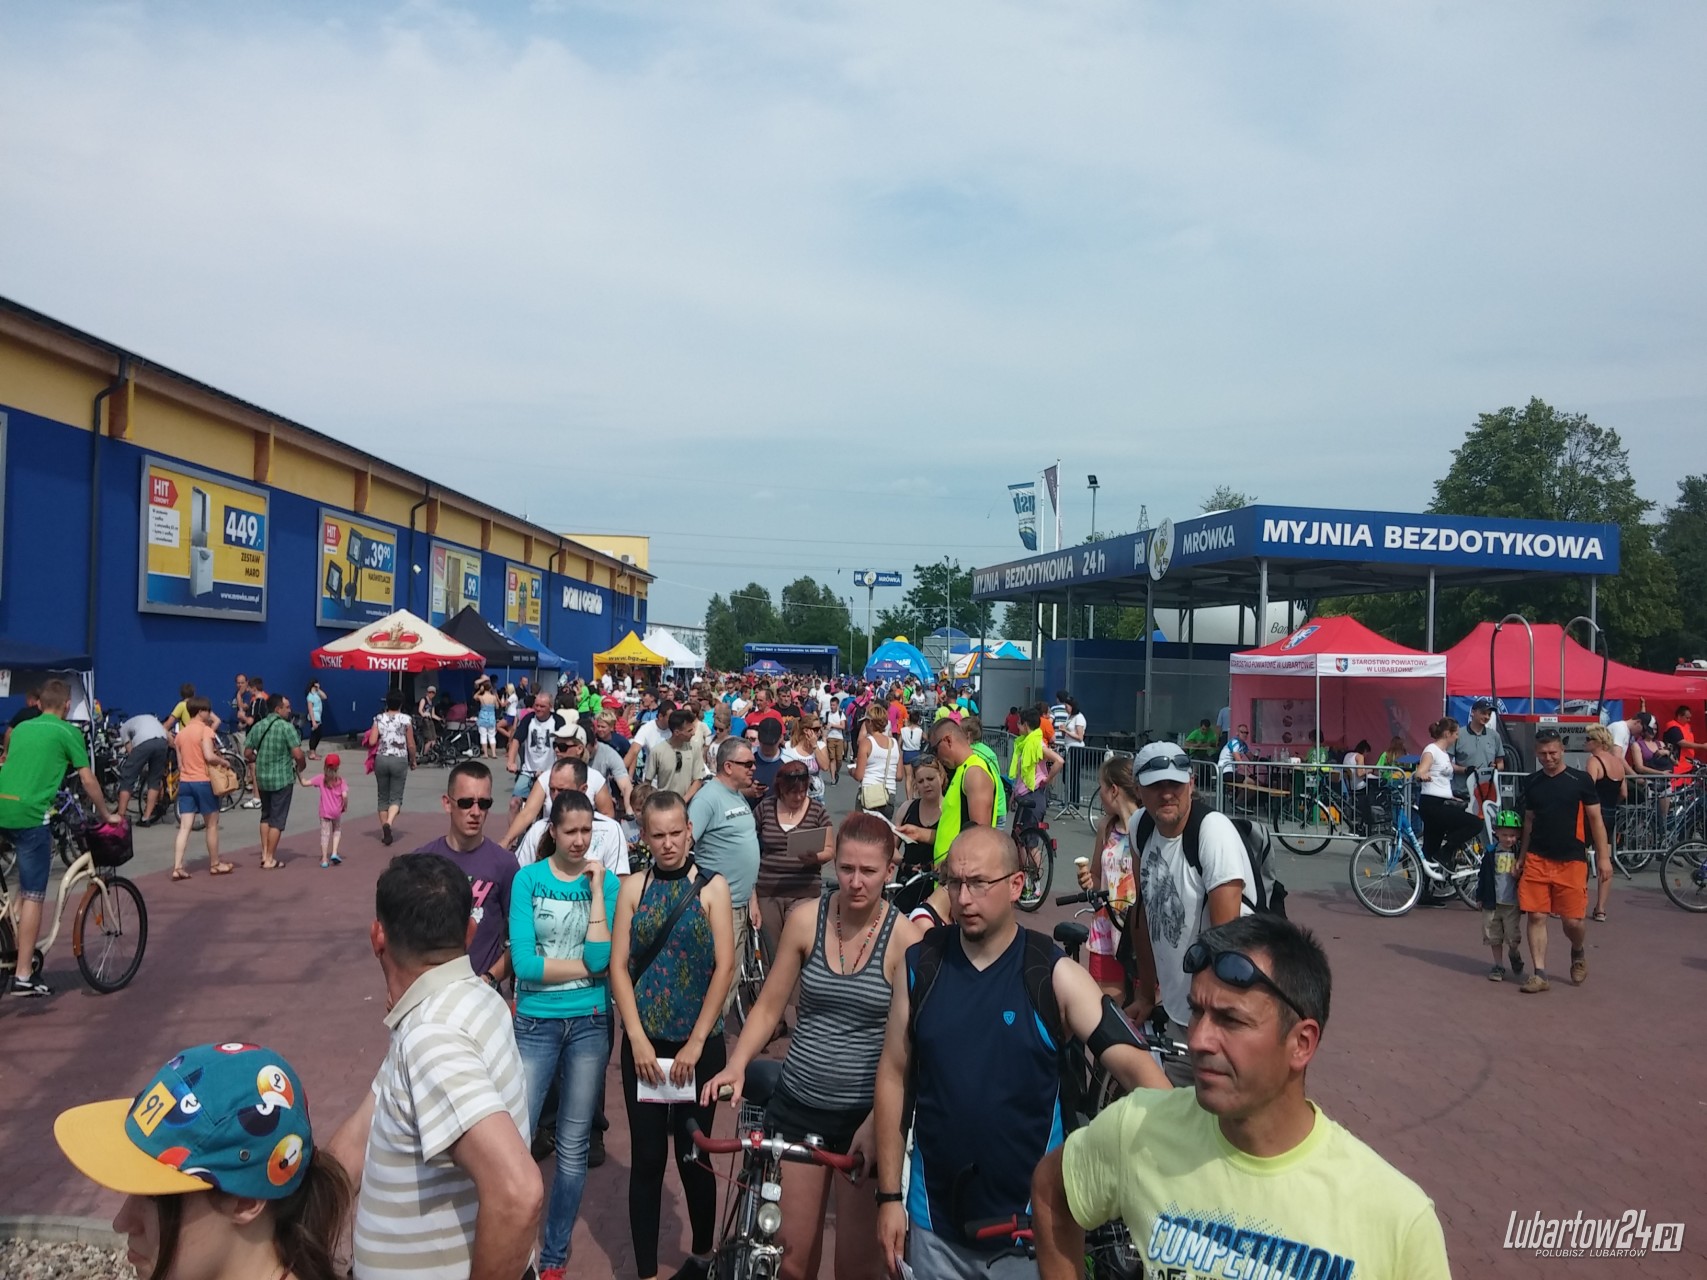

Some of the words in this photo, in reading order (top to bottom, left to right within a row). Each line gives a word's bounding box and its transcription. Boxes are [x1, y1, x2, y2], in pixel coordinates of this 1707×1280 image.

[153, 478, 169, 498] HIT
[326, 524, 337, 539] HIT
[1183, 524, 1235, 556] MRÓWKA
[1262, 519, 1373, 548] MYJNIA
[1384, 525, 1604, 560] BEZDOTYKOWA
[241, 552, 260, 564] ZESTAW
[244, 567, 260, 578] MARO
[973, 573, 999, 595] MYJNIA
[1004, 555, 1074, 590] BEZDOTYKOWA
[320, 654, 344, 669] TYSKIE
[366, 655, 409, 671] TYSKIE
[1281, 661, 1315, 670] LUBARTOWIE
[1558, 726, 1587, 734] ODKURZA
[532, 886, 593, 901] UNKNOW
[1147, 1213, 1355, 1280] COMPETITION
